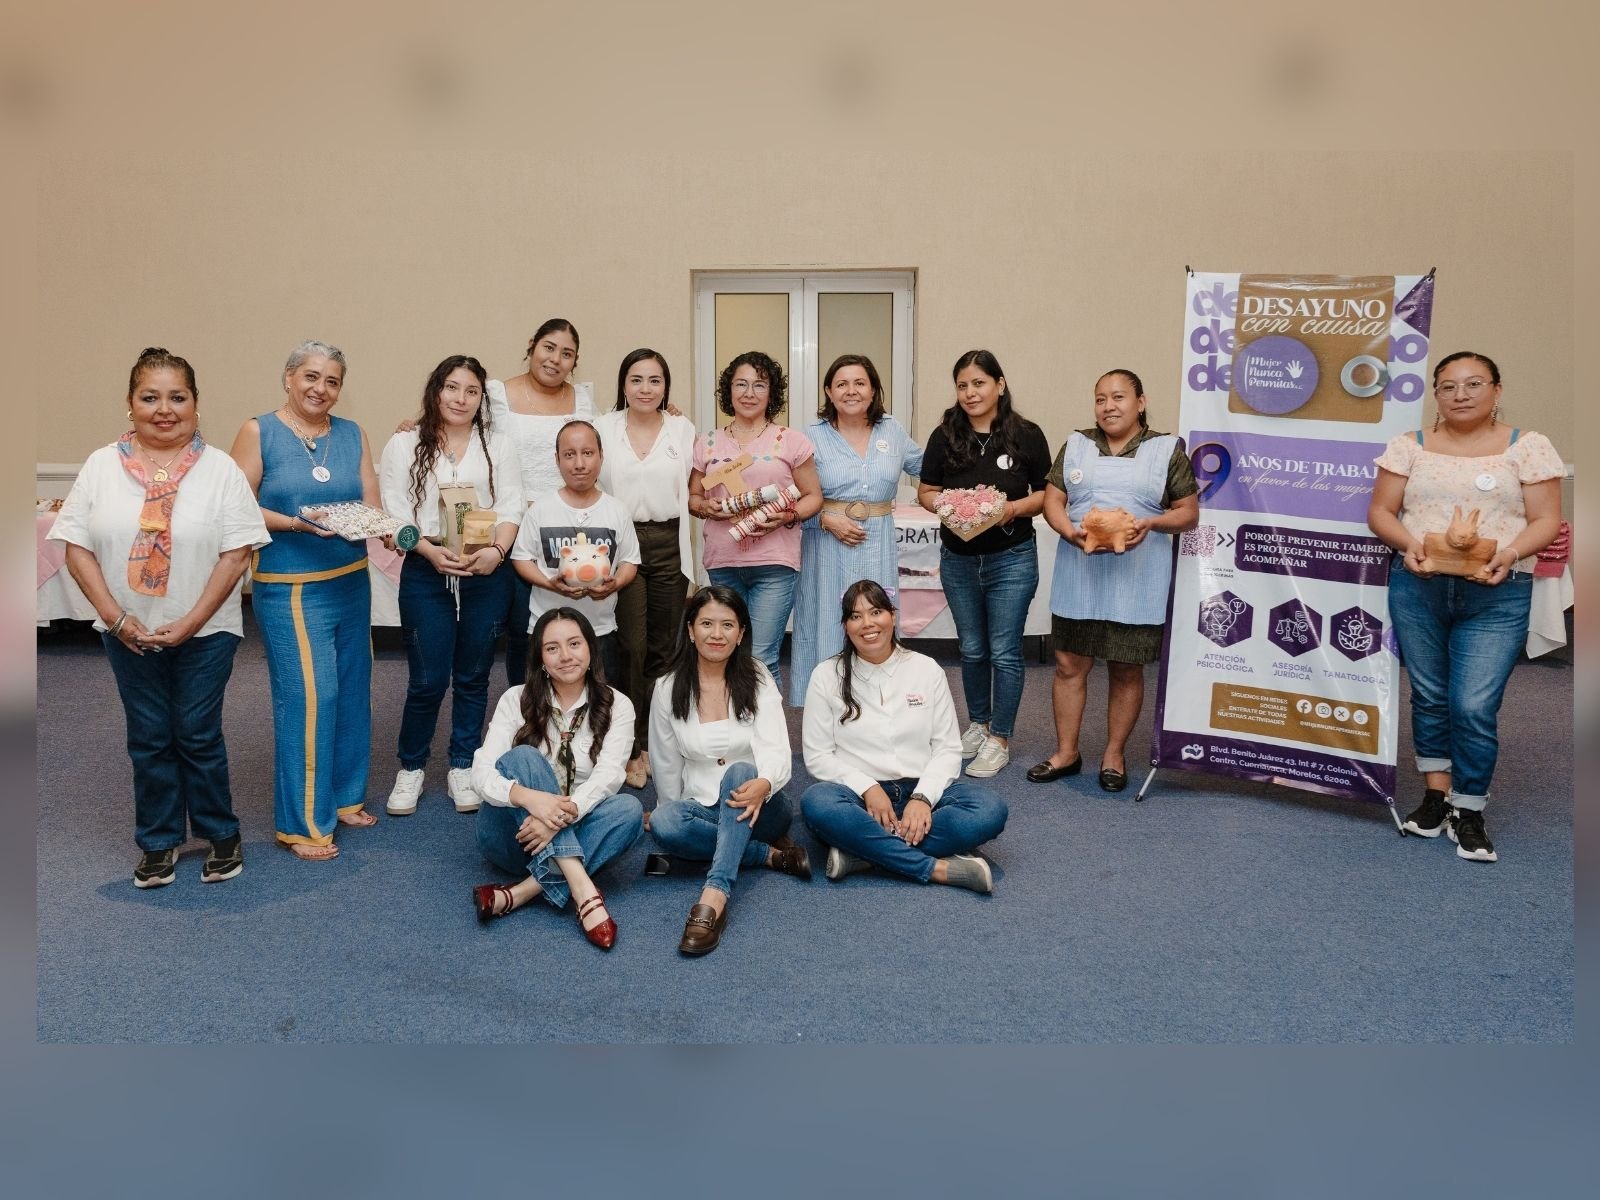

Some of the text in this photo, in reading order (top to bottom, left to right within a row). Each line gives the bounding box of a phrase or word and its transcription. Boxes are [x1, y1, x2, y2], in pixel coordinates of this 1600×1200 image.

[1242, 296, 1386, 319] DESAYUNO
[1241, 317, 1386, 336] con causa
[1251, 357, 1282, 368] Mujer
[1190, 442, 1231, 502] 9
[1237, 453, 1281, 470] AÑOS
[1285, 460, 1309, 473] DE
[1238, 475, 1253, 483] en
[1249, 469, 1289, 493] favor
[1292, 477, 1309, 489] de
[1310, 475, 1331, 491] las
[1245, 532, 1393, 554] PORQUE PREVENIR TAMBIÉN
[1243, 554, 1307, 568] ACOMPAÑAR
[1244, 543, 1256, 551] ES
[1315, 551, 1374, 564] INFORMAR
[1375, 557, 1384, 565] Y
[1196, 660, 1254, 673] PSICOLÓGICA
[1203, 653, 1246, 664] ATENCIÓN
[1272, 661, 1313, 673] ASESORÍA
[1273, 670, 1311, 681] JURÍDICA
[1323, 670, 1385, 685] TANATOLOGA
[1210, 745, 1229, 754] Blvd.
[1231, 748, 1257, 759] Benito
[1258, 752, 1284, 763] Juárez
[1298, 760, 1309, 768] Int
[1327, 764, 1358, 777] Colonia
